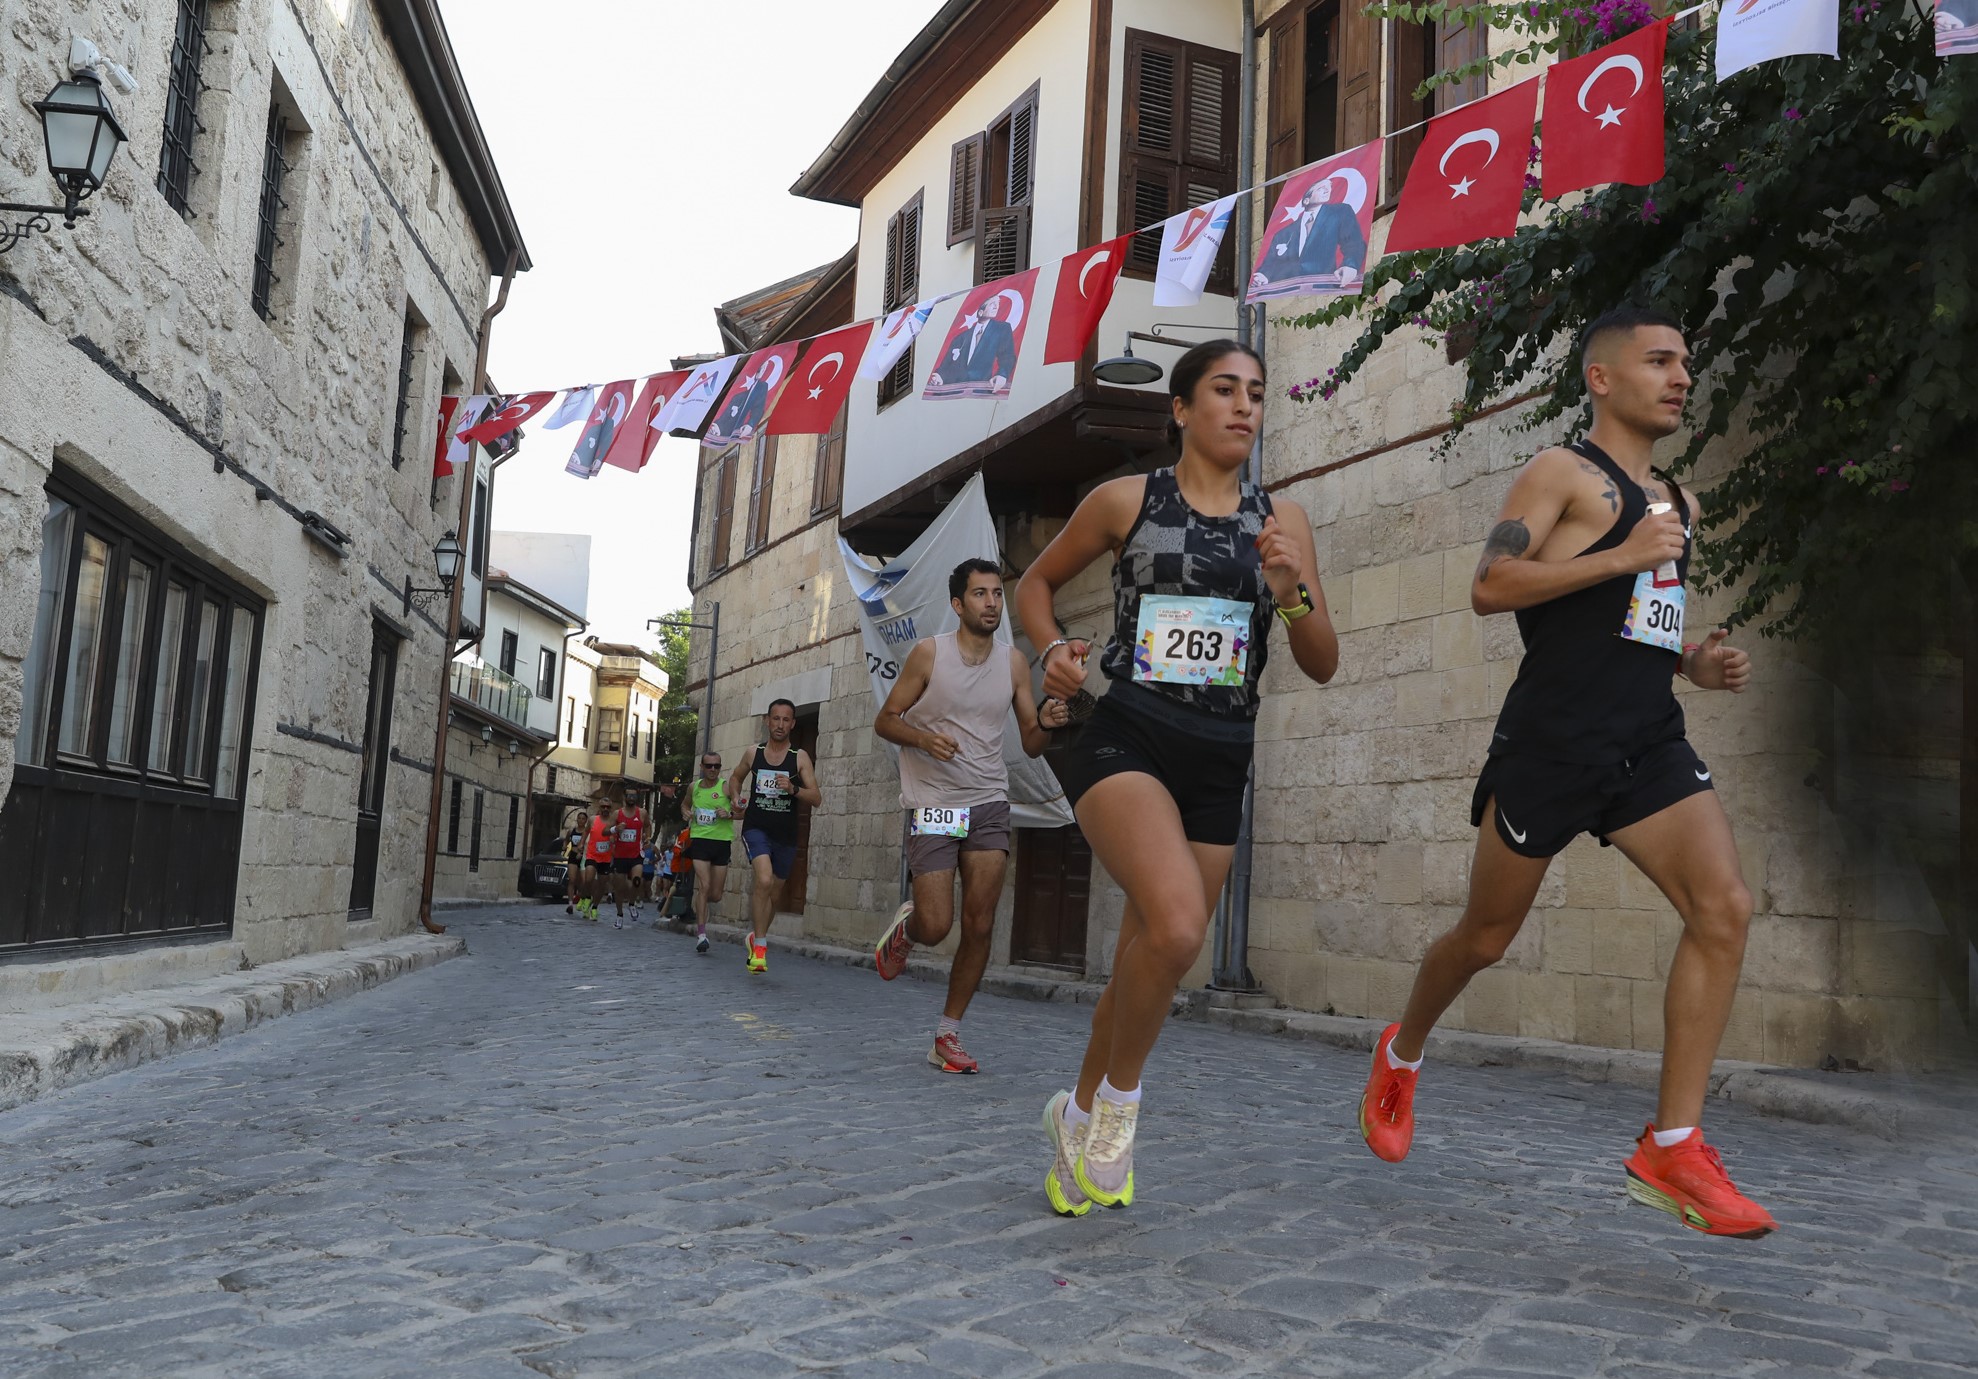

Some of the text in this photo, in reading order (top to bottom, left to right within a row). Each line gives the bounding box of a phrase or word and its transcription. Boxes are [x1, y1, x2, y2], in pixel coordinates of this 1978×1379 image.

[1646, 599, 1680, 637] 304
[1165, 628, 1223, 661] 263
[698, 814, 711, 822] 473
[923, 807, 954, 824] 530
